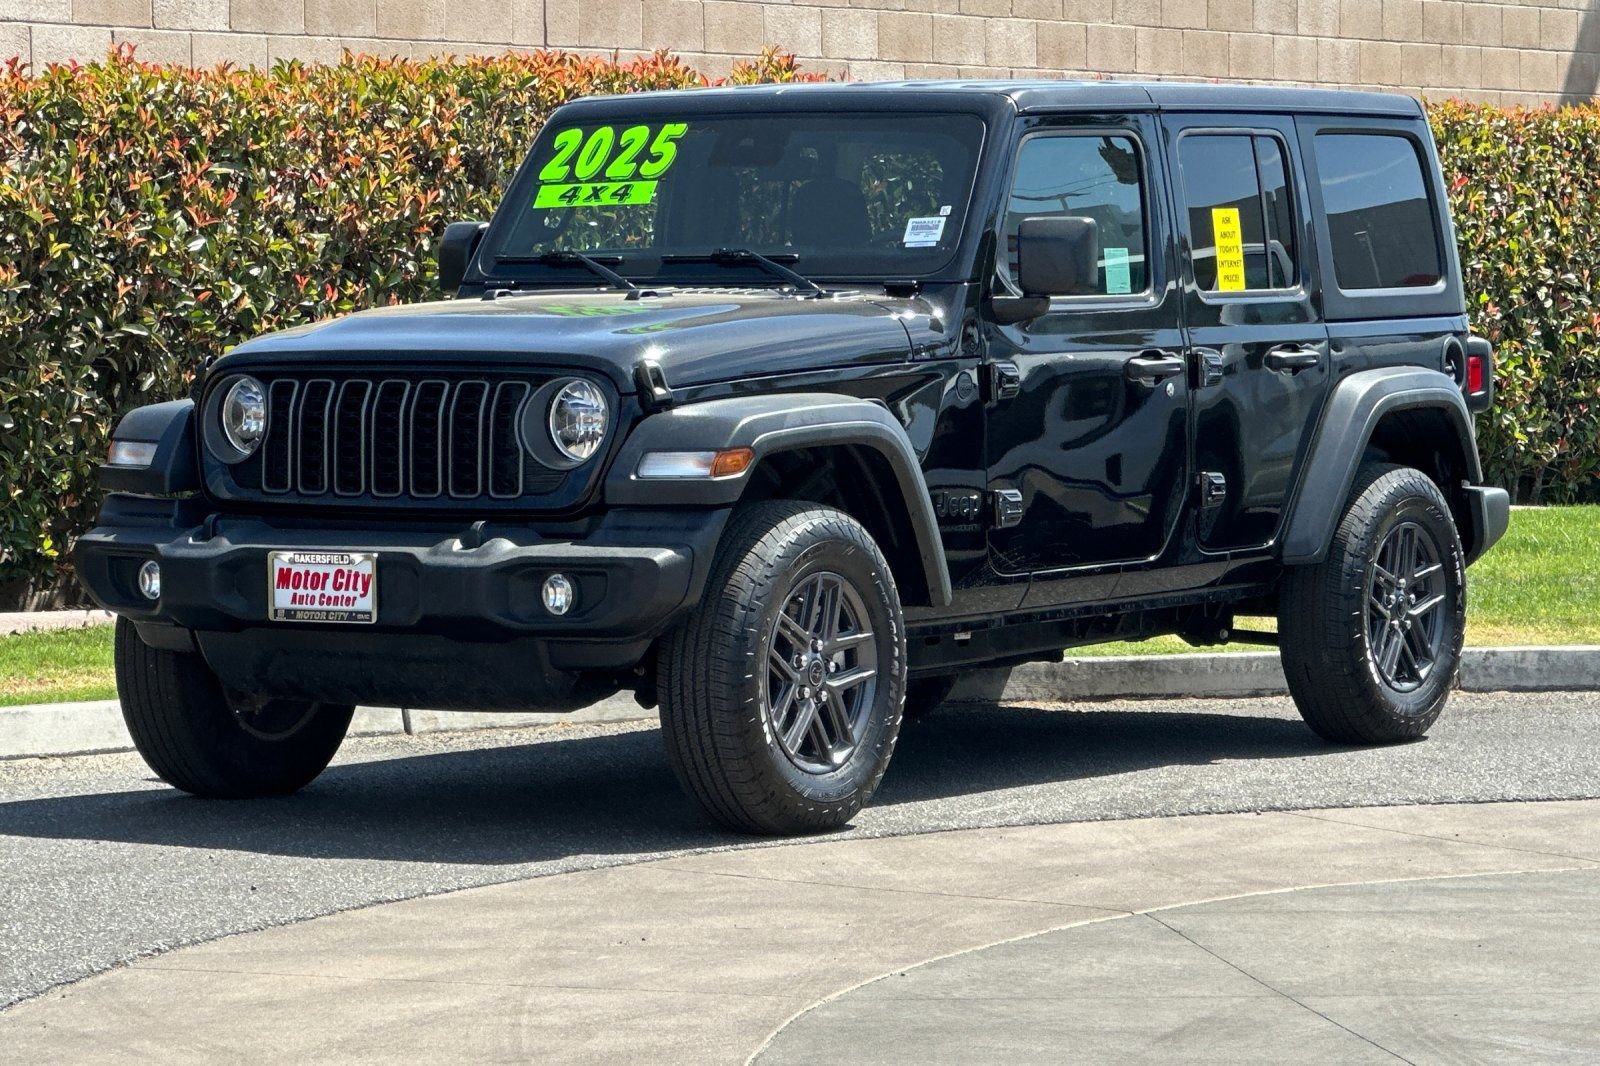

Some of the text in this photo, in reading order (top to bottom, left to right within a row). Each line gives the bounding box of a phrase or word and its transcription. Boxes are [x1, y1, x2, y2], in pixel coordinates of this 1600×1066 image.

[538, 123, 689, 181] 2025
[1221, 216, 1231, 225] ASK
[1219, 231, 1236, 239] ABOUT
[1219, 245, 1240, 253] TODAY'S
[1218, 259, 1242, 268] INTERNET
[936, 491, 980, 521] Jeep
[294, 554, 350, 565] BAKERSFIELD
[276, 567, 373, 599] Motor City
[290, 592, 357, 607] Auto Center
[295, 610, 327, 620] MOTOR
[328, 611, 350, 621] CITY
